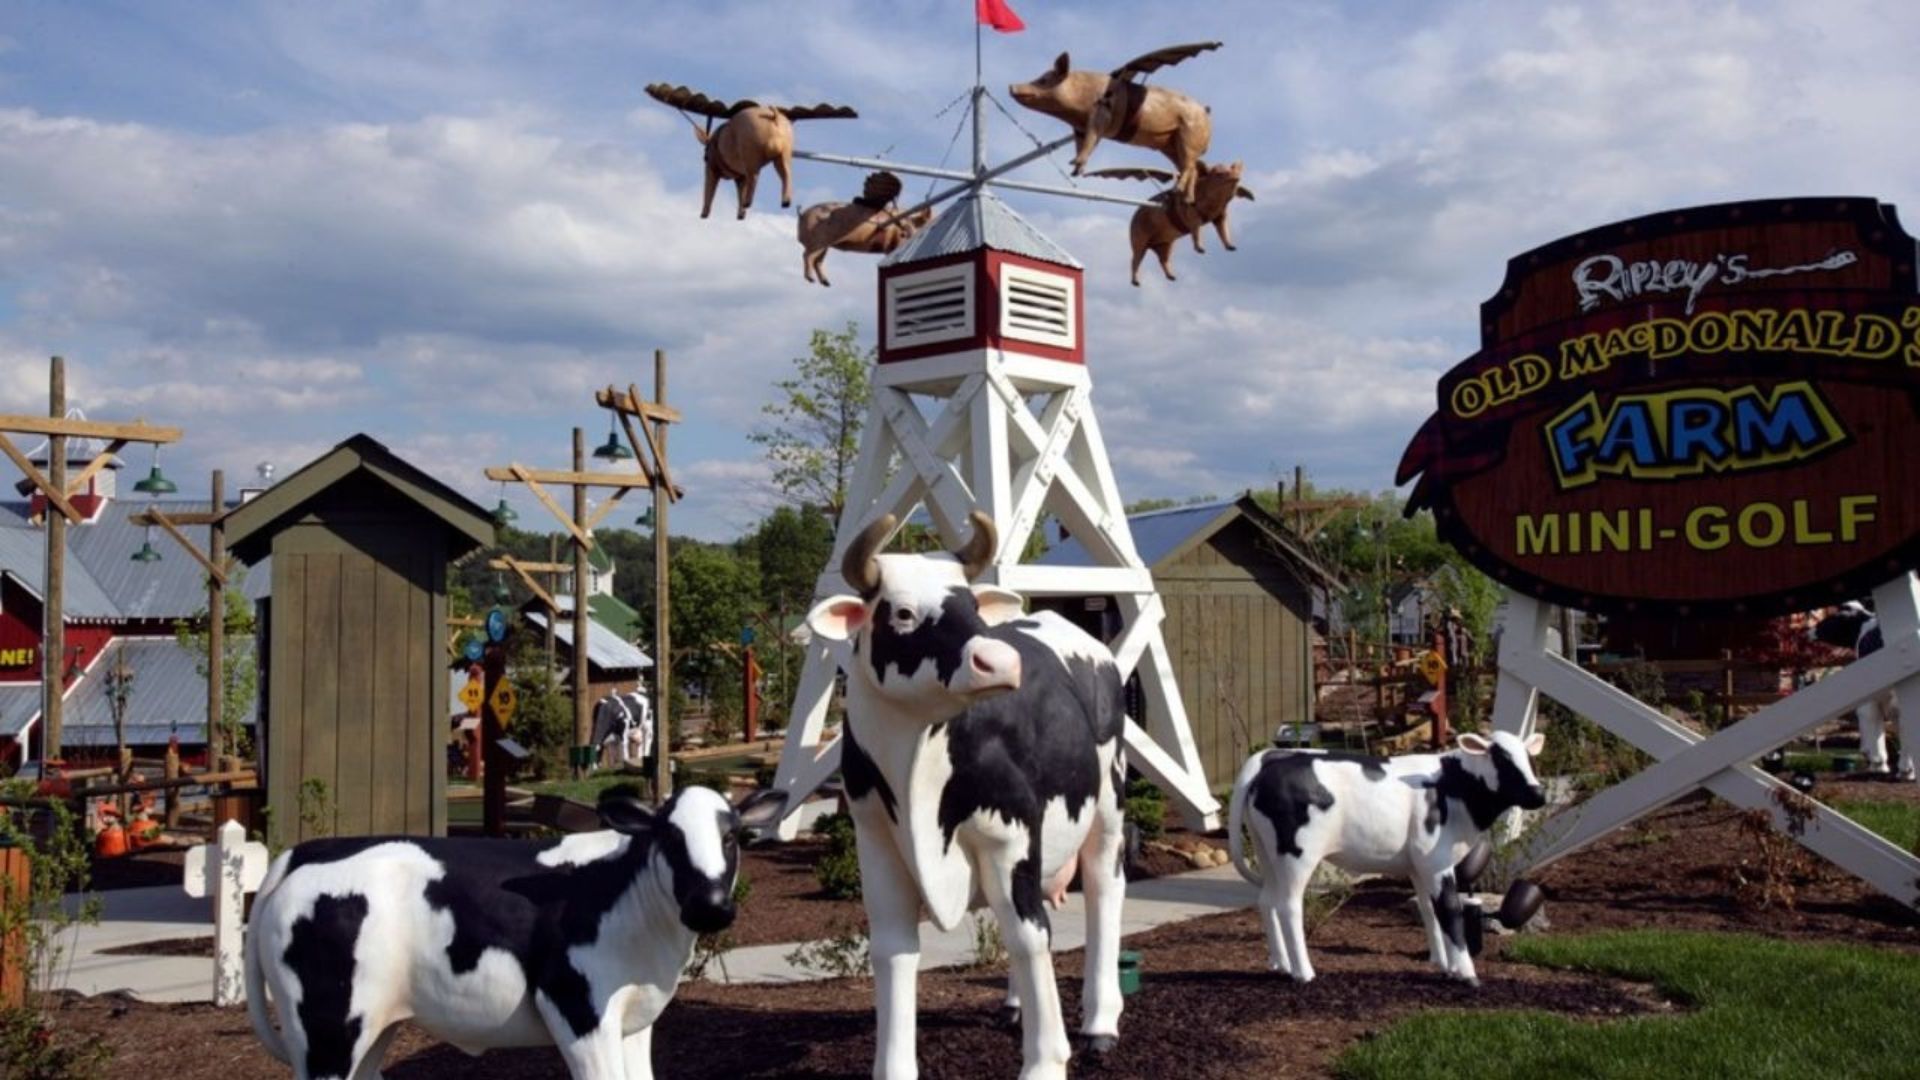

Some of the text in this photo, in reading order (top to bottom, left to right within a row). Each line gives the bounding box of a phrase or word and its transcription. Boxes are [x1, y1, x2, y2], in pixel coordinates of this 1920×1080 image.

[1452, 355, 1550, 418] OLD
[1552, 394, 1828, 472] FARM
[1515, 495, 1878, 555] MINI-GOLF
